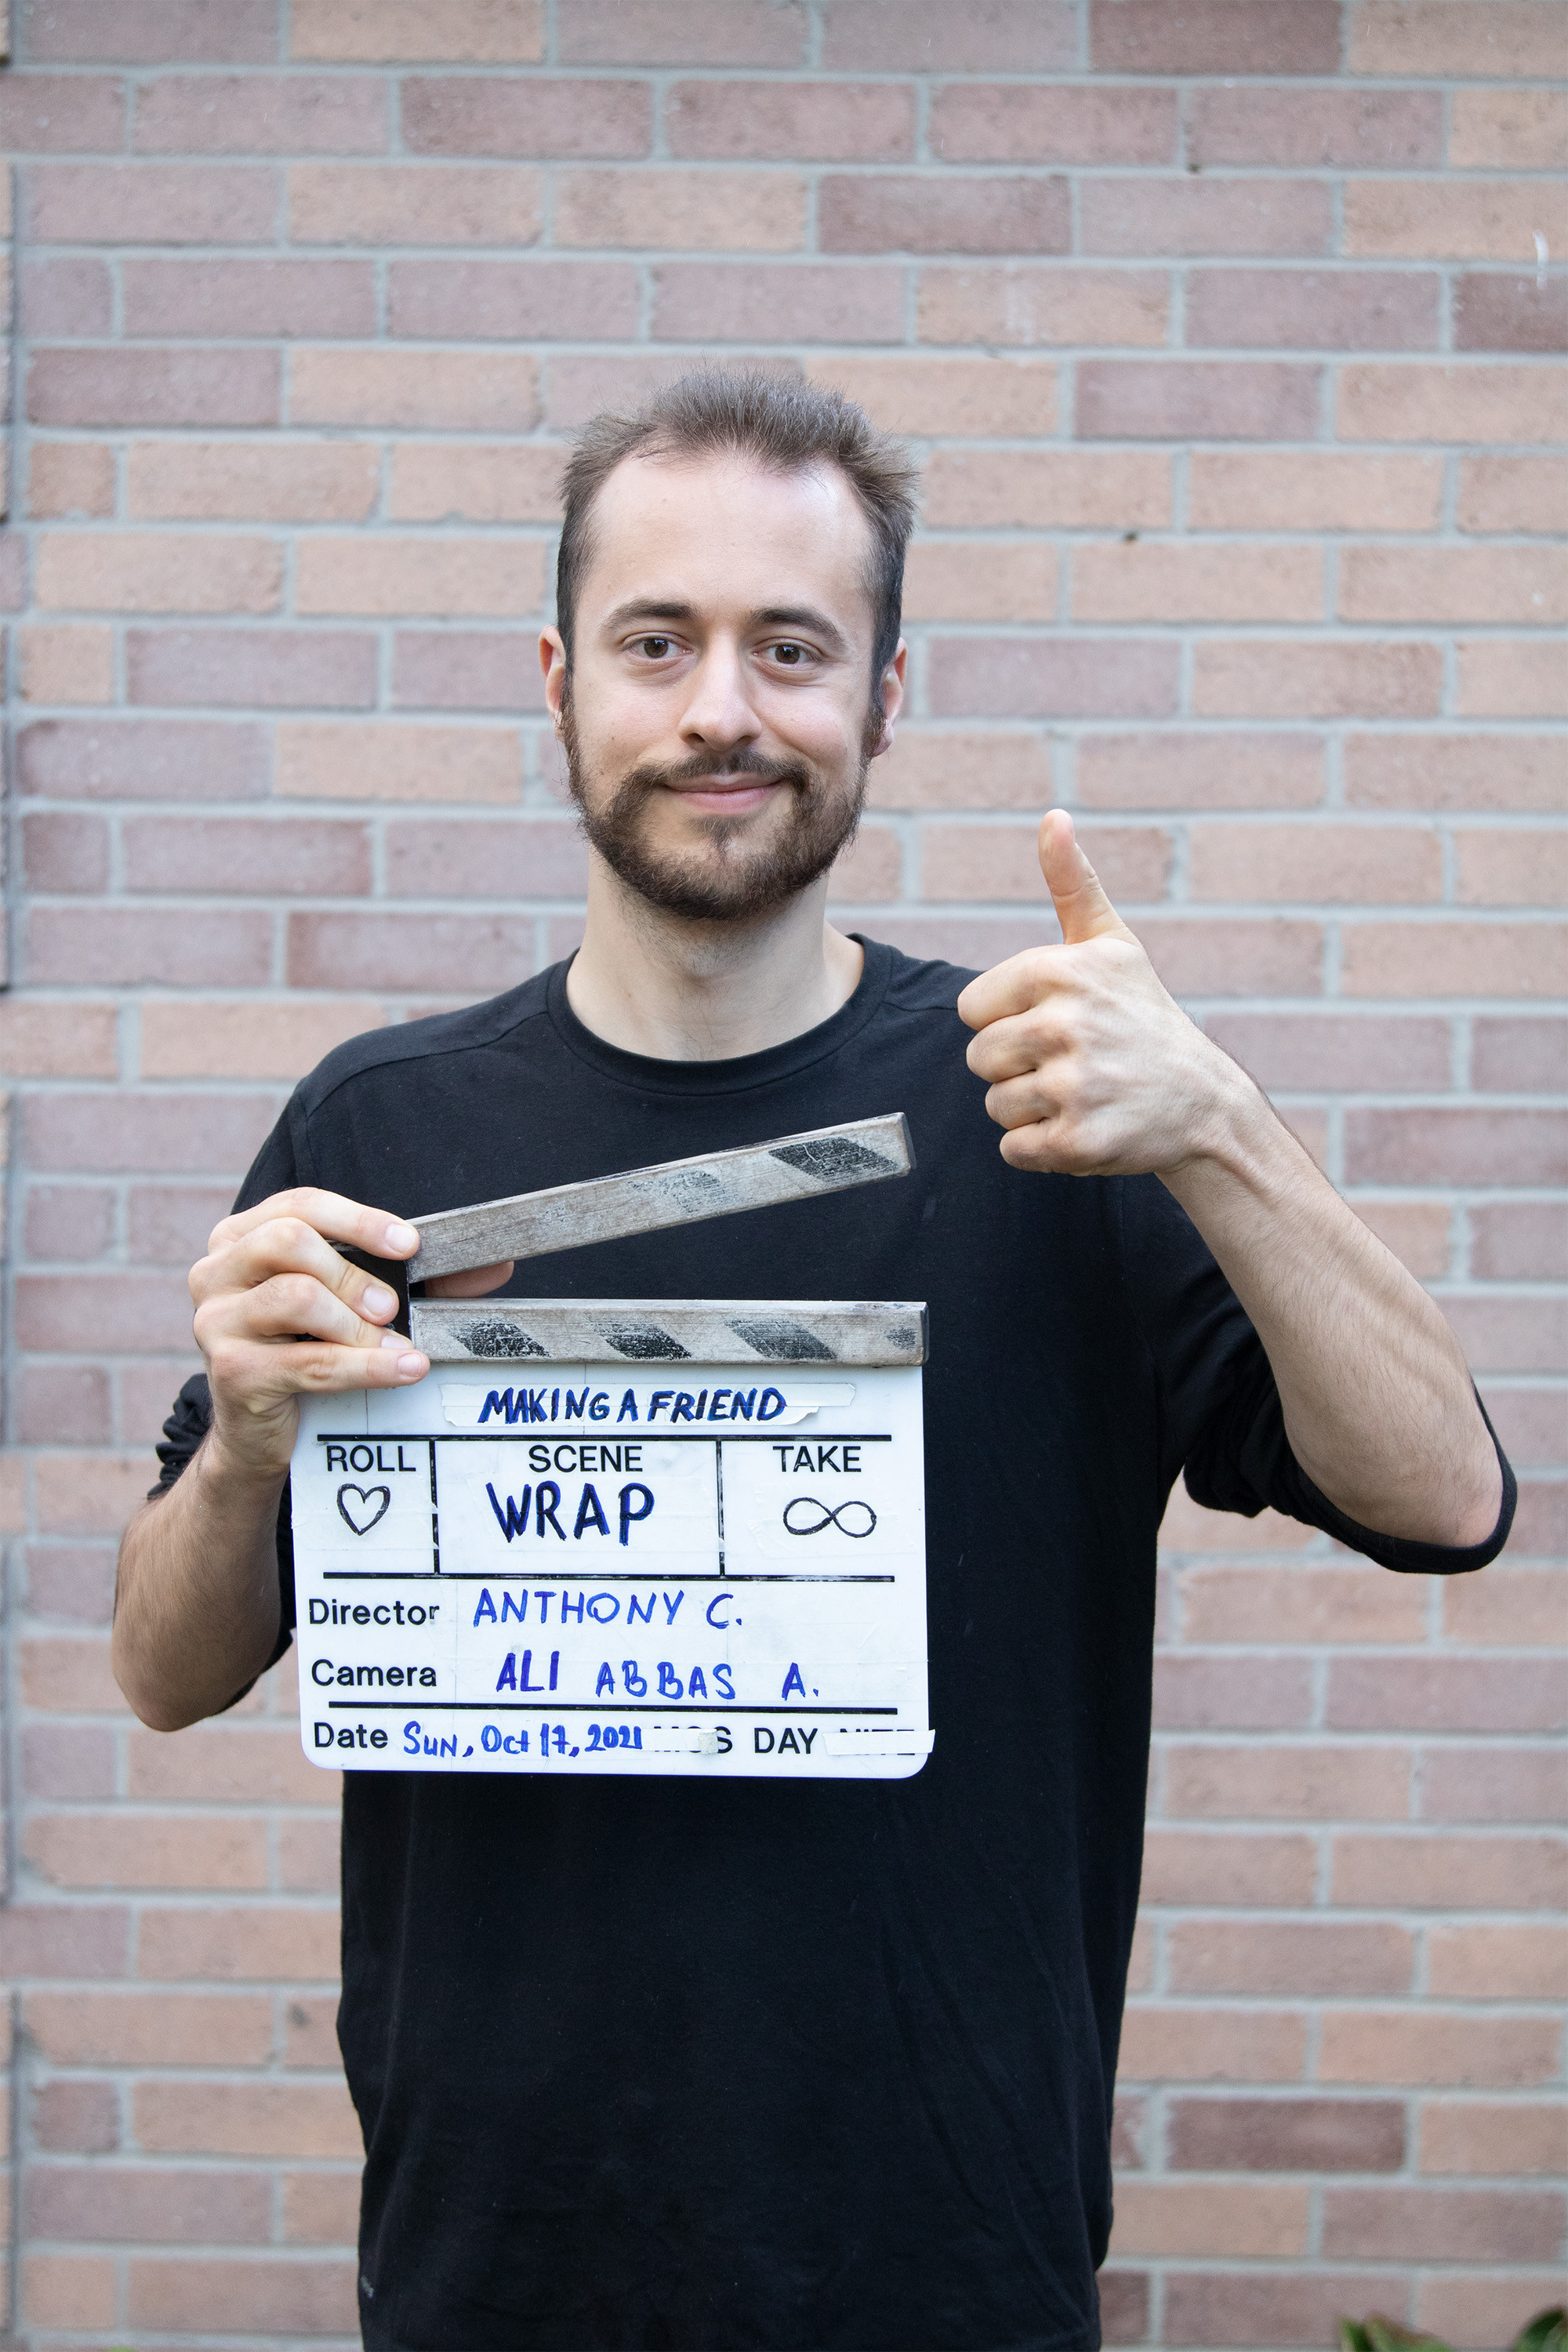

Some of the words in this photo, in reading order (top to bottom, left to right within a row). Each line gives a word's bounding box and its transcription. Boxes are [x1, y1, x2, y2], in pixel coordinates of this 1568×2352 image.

[476, 1386, 611, 1425] MAKING
[615, 1388, 639, 1423] A
[647, 1387, 788, 1423] FRIEND
[326, 1444, 417, 1472] ROLL
[528, 1444, 643, 1472] SCENE
[772, 1445, 862, 1472] TAKE
[485, 1480, 655, 1547] WRAP
[309, 1598, 440, 1625] Director
[473, 1588, 685, 1628] ANTHONY
[706, 1593, 742, 1629] C.
[311, 1658, 437, 1686] Camera
[495, 1649, 561, 1693] ALI
[595, 1660, 736, 1700] ABBAS
[781, 1661, 819, 1701] A.
[314, 1722, 389, 1749] Date
[481, 1725, 531, 1755] Oct
[584, 1723, 643, 1752] 2021
[753, 1727, 818, 1755] DAY
